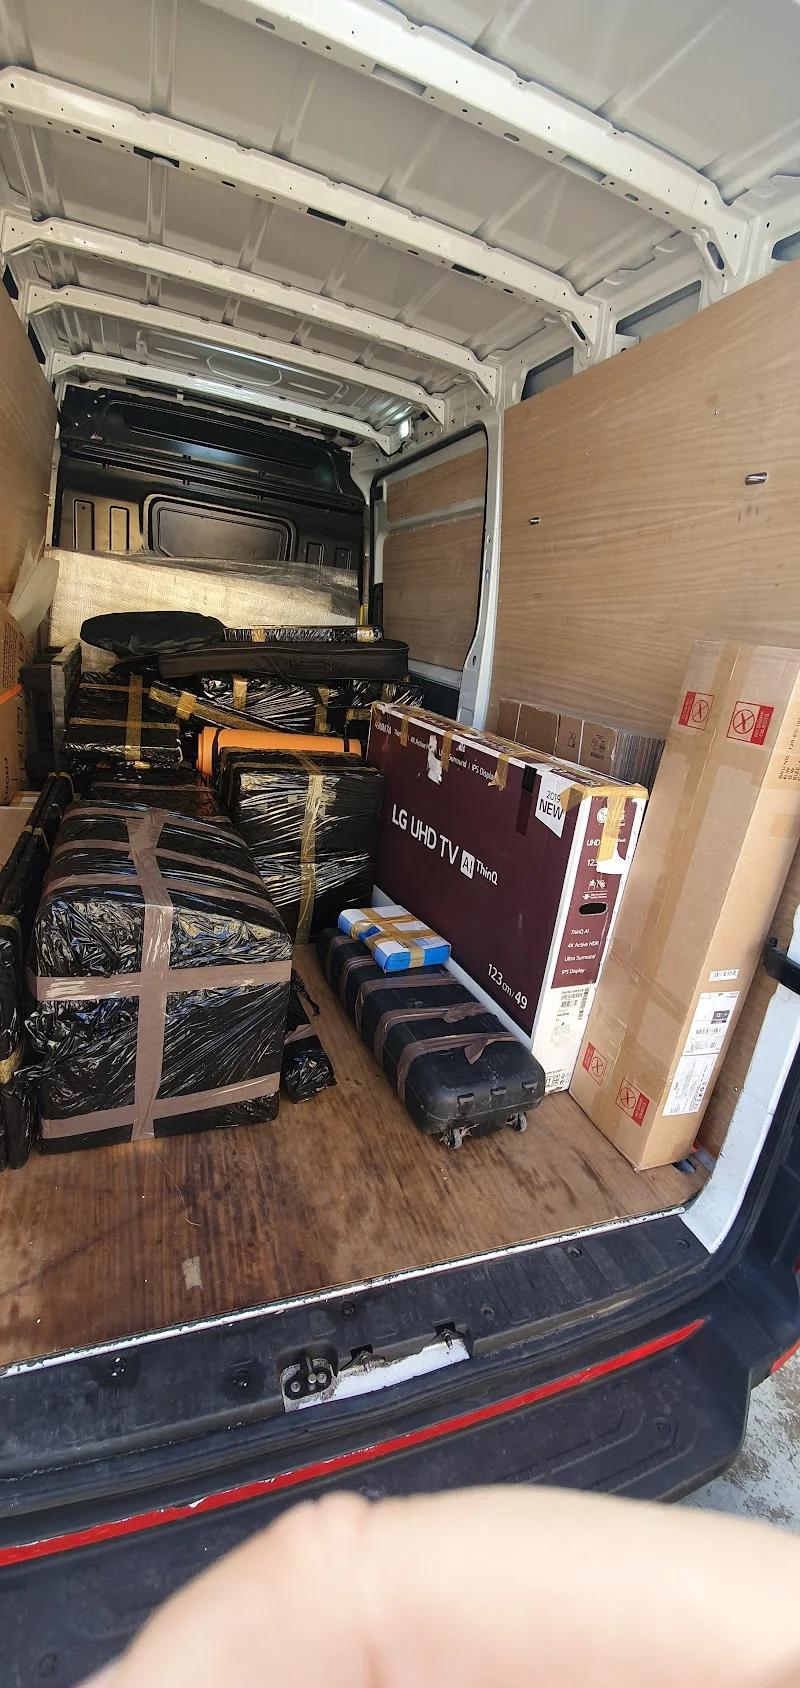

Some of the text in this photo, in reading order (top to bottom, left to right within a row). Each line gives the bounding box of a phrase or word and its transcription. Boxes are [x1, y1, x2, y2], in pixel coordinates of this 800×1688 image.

[472, 763, 480, 774] IPS
[539, 799, 563, 820] NEW
[392, 804, 498, 886] LG UHD TV AI ThinQ
[586, 839, 601, 847] UHD
[488, 963, 503, 985] 123
